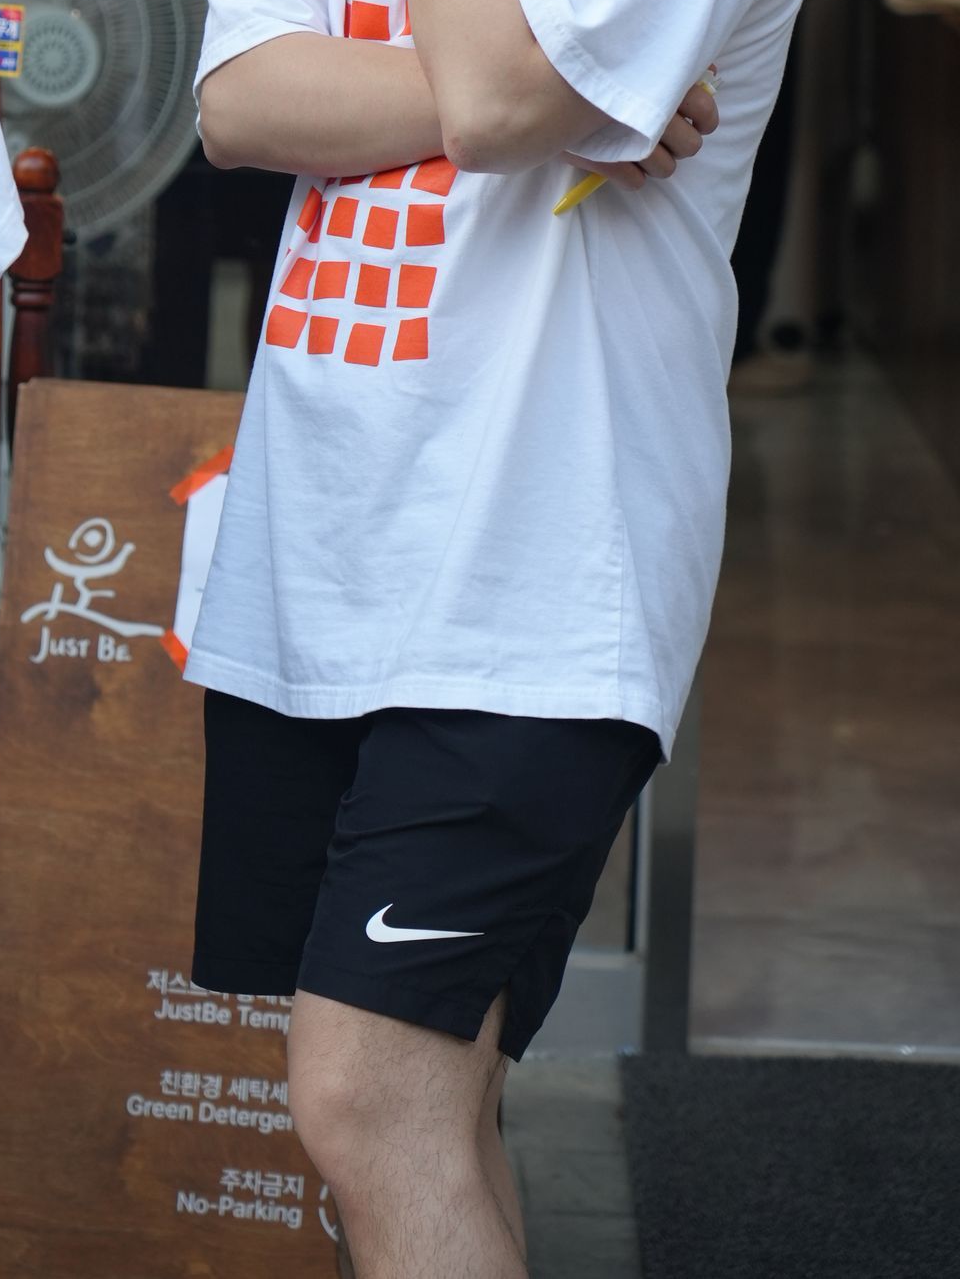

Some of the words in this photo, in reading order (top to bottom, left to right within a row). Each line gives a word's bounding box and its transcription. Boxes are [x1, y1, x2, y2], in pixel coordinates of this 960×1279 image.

[153, 998, 233, 1026] JustBe
[159, 1070, 223, 1097] 친환경
[126, 1094, 194, 1121] Green
[220, 1168, 304, 1200] 주차금지
[176, 1191, 302, 1229] No-Parking
